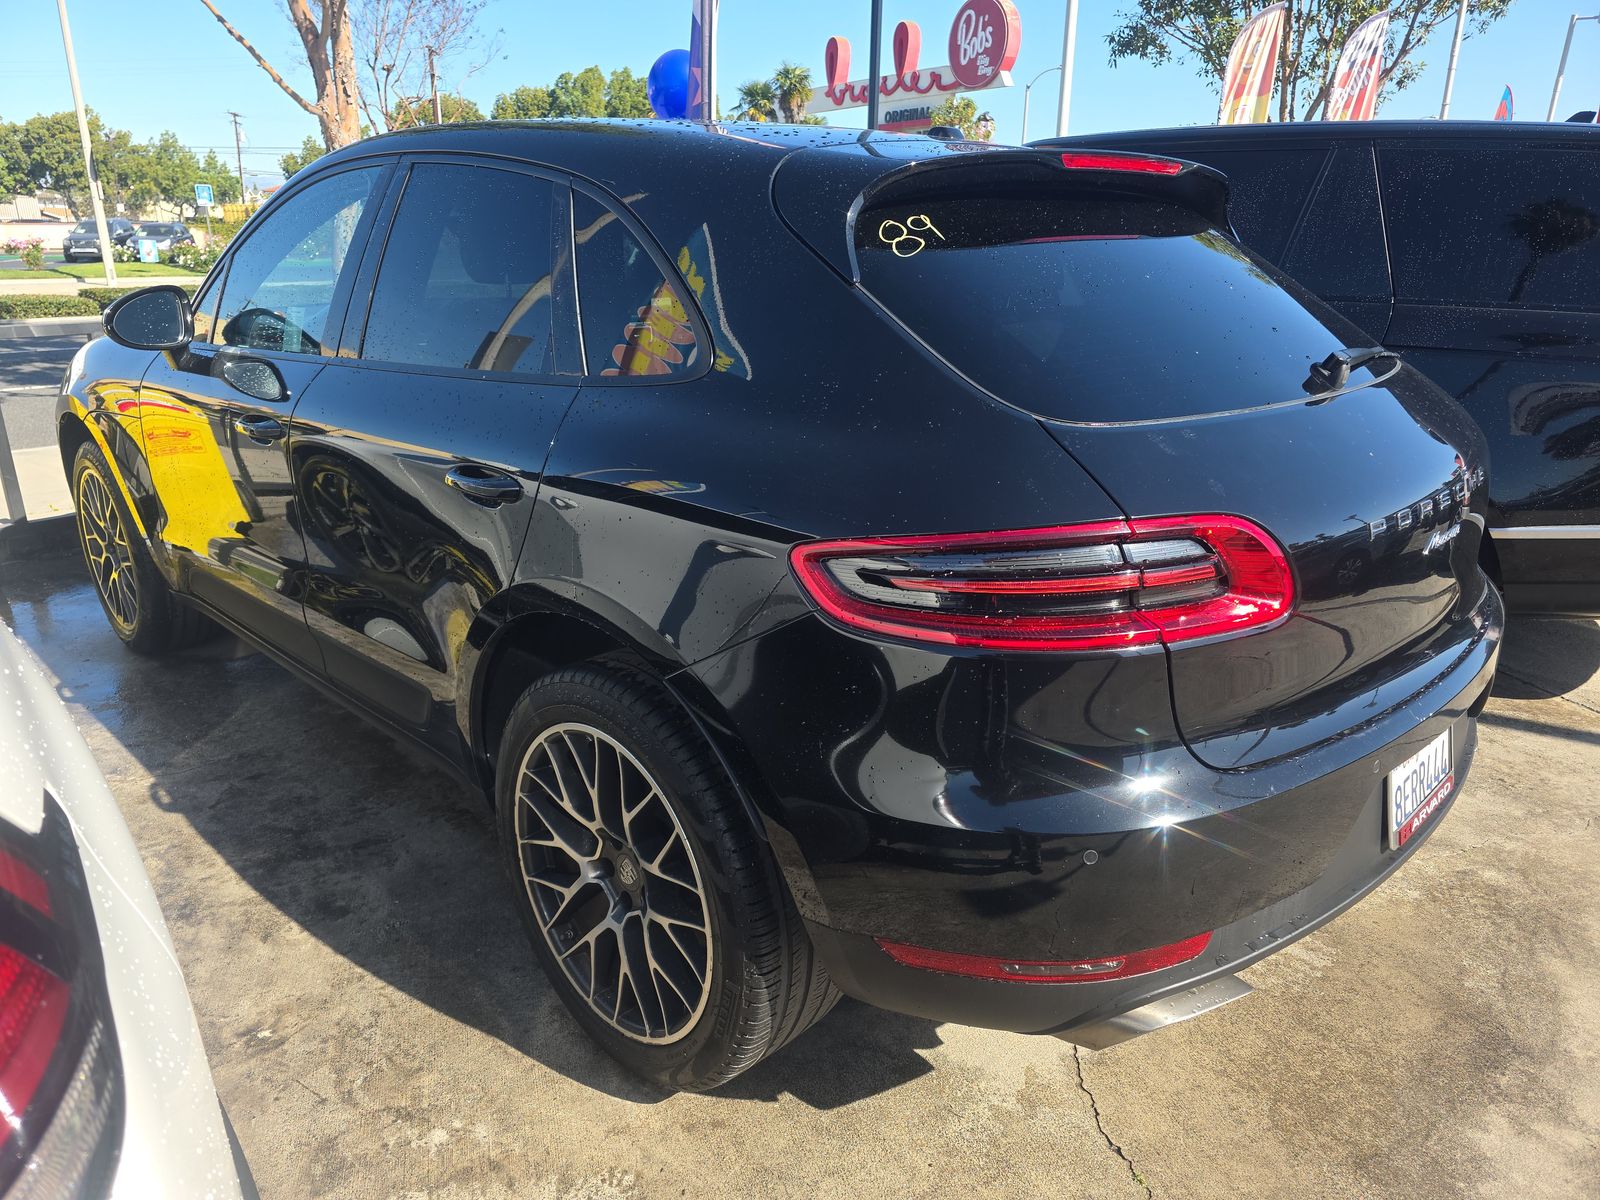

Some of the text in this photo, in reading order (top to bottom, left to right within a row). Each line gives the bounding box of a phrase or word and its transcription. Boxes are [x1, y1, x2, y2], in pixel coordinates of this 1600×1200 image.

[957, 8, 993, 66] Bob's
[976, 54, 990, 66] Big
[977, 64, 993, 77] Boy
[884, 105, 931, 124] ORIGINAL
[878, 214, 946, 258] 89
[1368, 465, 1485, 542] PORSCHE
[1394, 739, 1449, 829] 8ERR444
